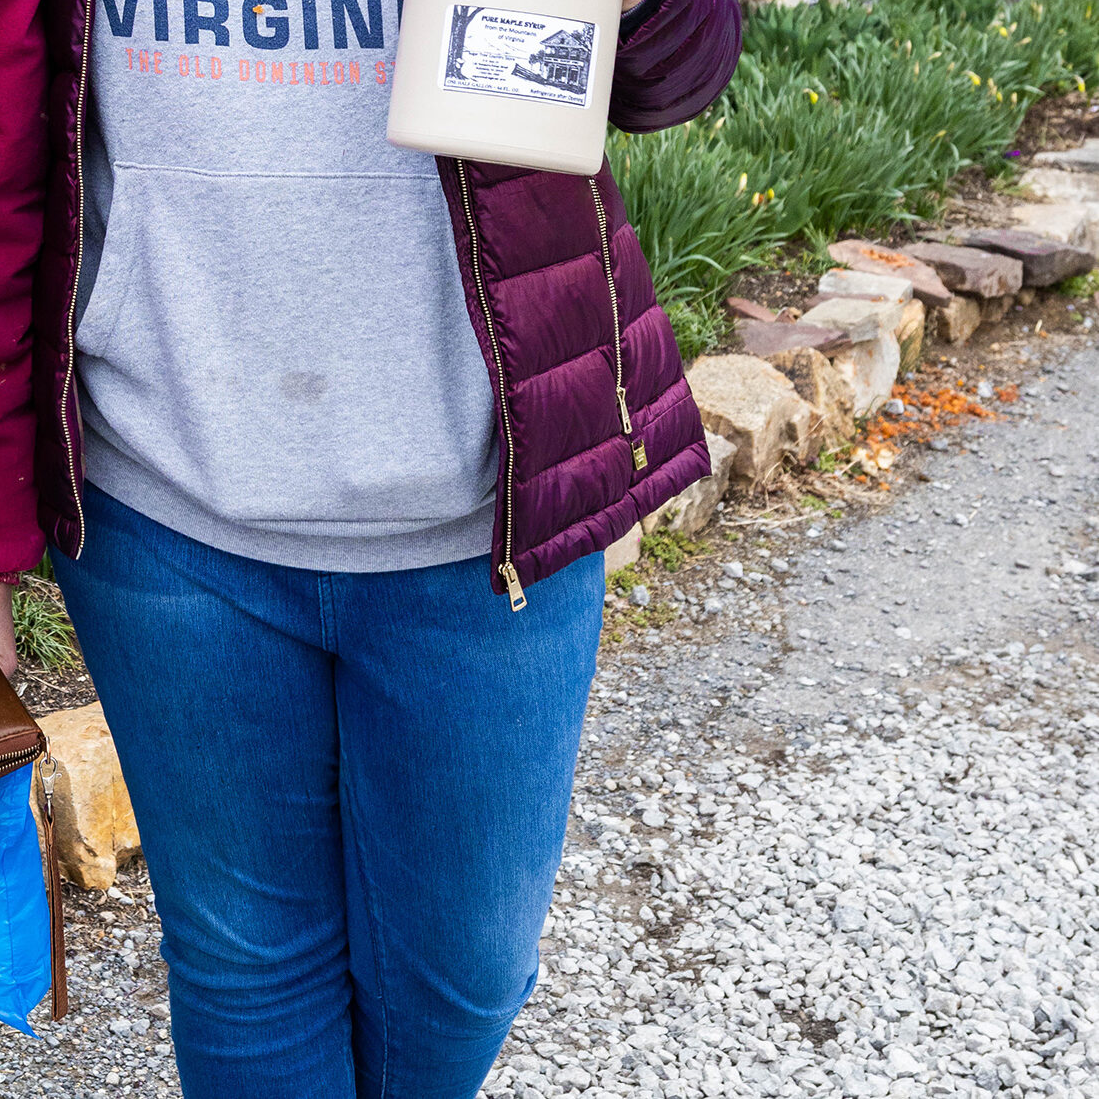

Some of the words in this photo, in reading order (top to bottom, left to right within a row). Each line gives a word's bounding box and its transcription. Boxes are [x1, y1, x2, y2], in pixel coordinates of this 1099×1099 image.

[481, 15, 499, 23] PURE
[500, 18, 523, 27] MAPLE
[524, 21, 547, 30] SYRUP
[509, 28, 537, 37] Mountains
[505, 35, 525, 43] Virginia
[125, 48, 162, 75] THE
[178, 54, 222, 80] OLD
[238, 59, 361, 85] DOMINION
